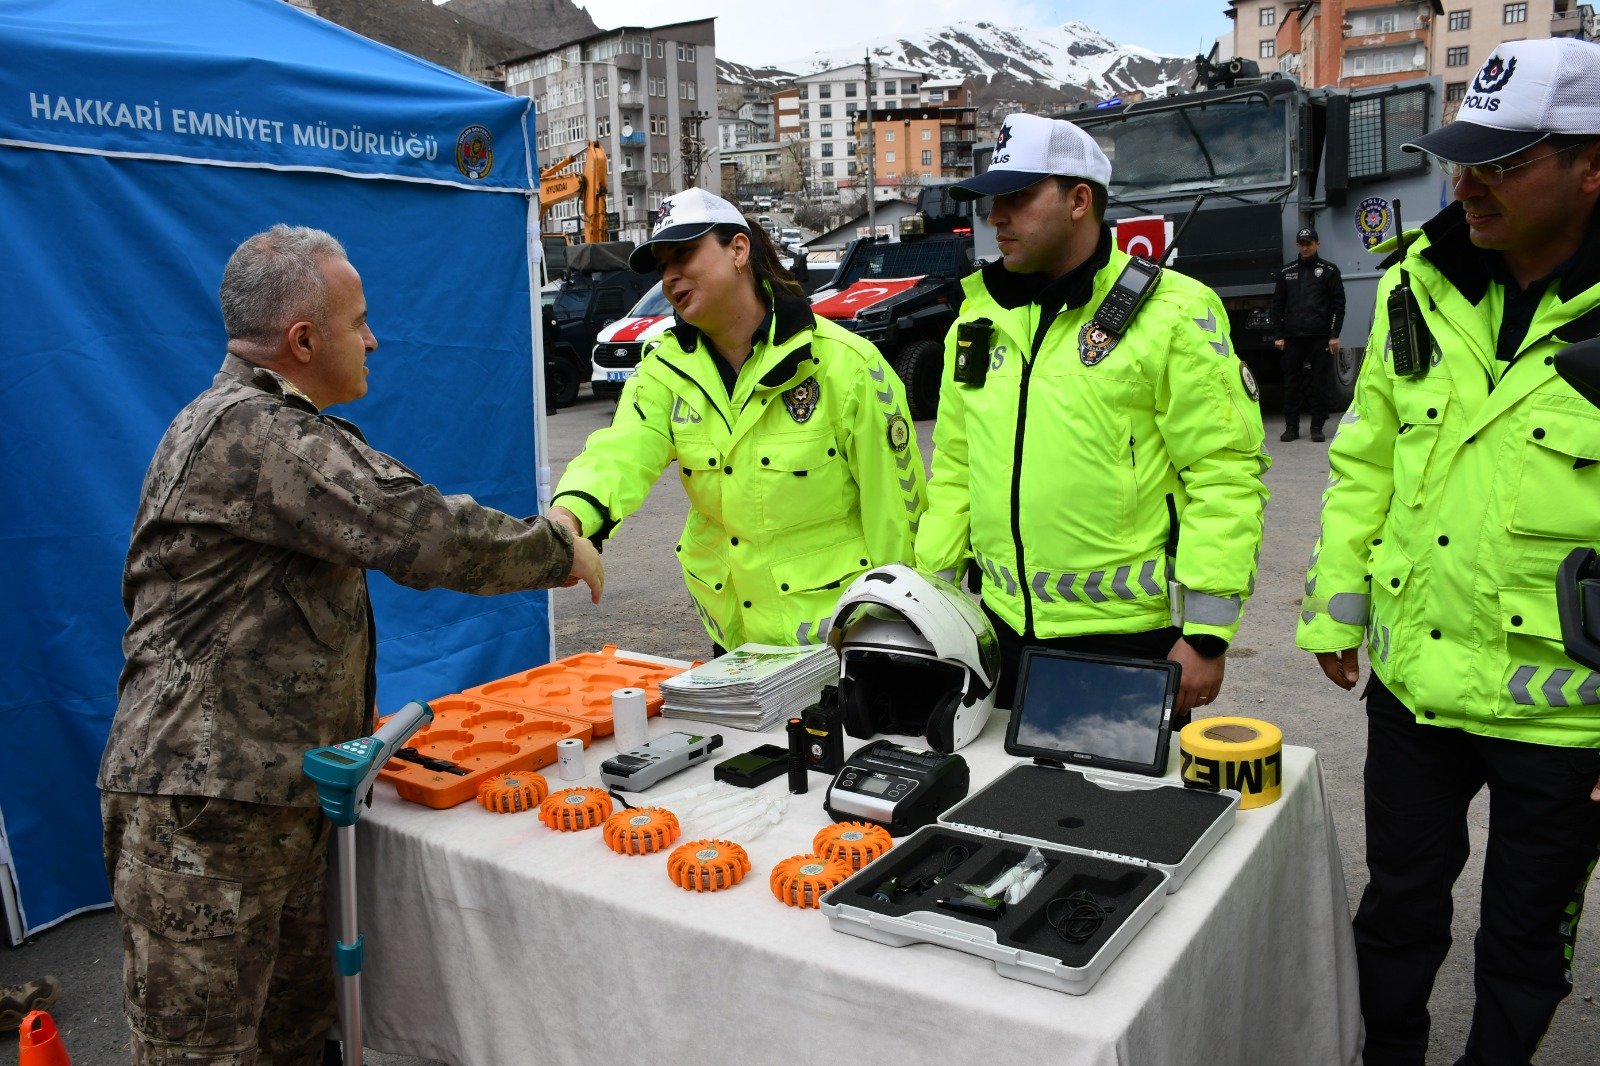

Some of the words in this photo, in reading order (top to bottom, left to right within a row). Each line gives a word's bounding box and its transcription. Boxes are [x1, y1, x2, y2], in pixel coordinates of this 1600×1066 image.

[29, 92, 162, 131] HAKKARİ
[172, 109, 284, 144] EMNİYET
[292, 120, 438, 161] MÜDÜRLÜĞÜ
[545, 182, 568, 194] HYUNDAI
[1362, 198, 1386, 207] POLİS
